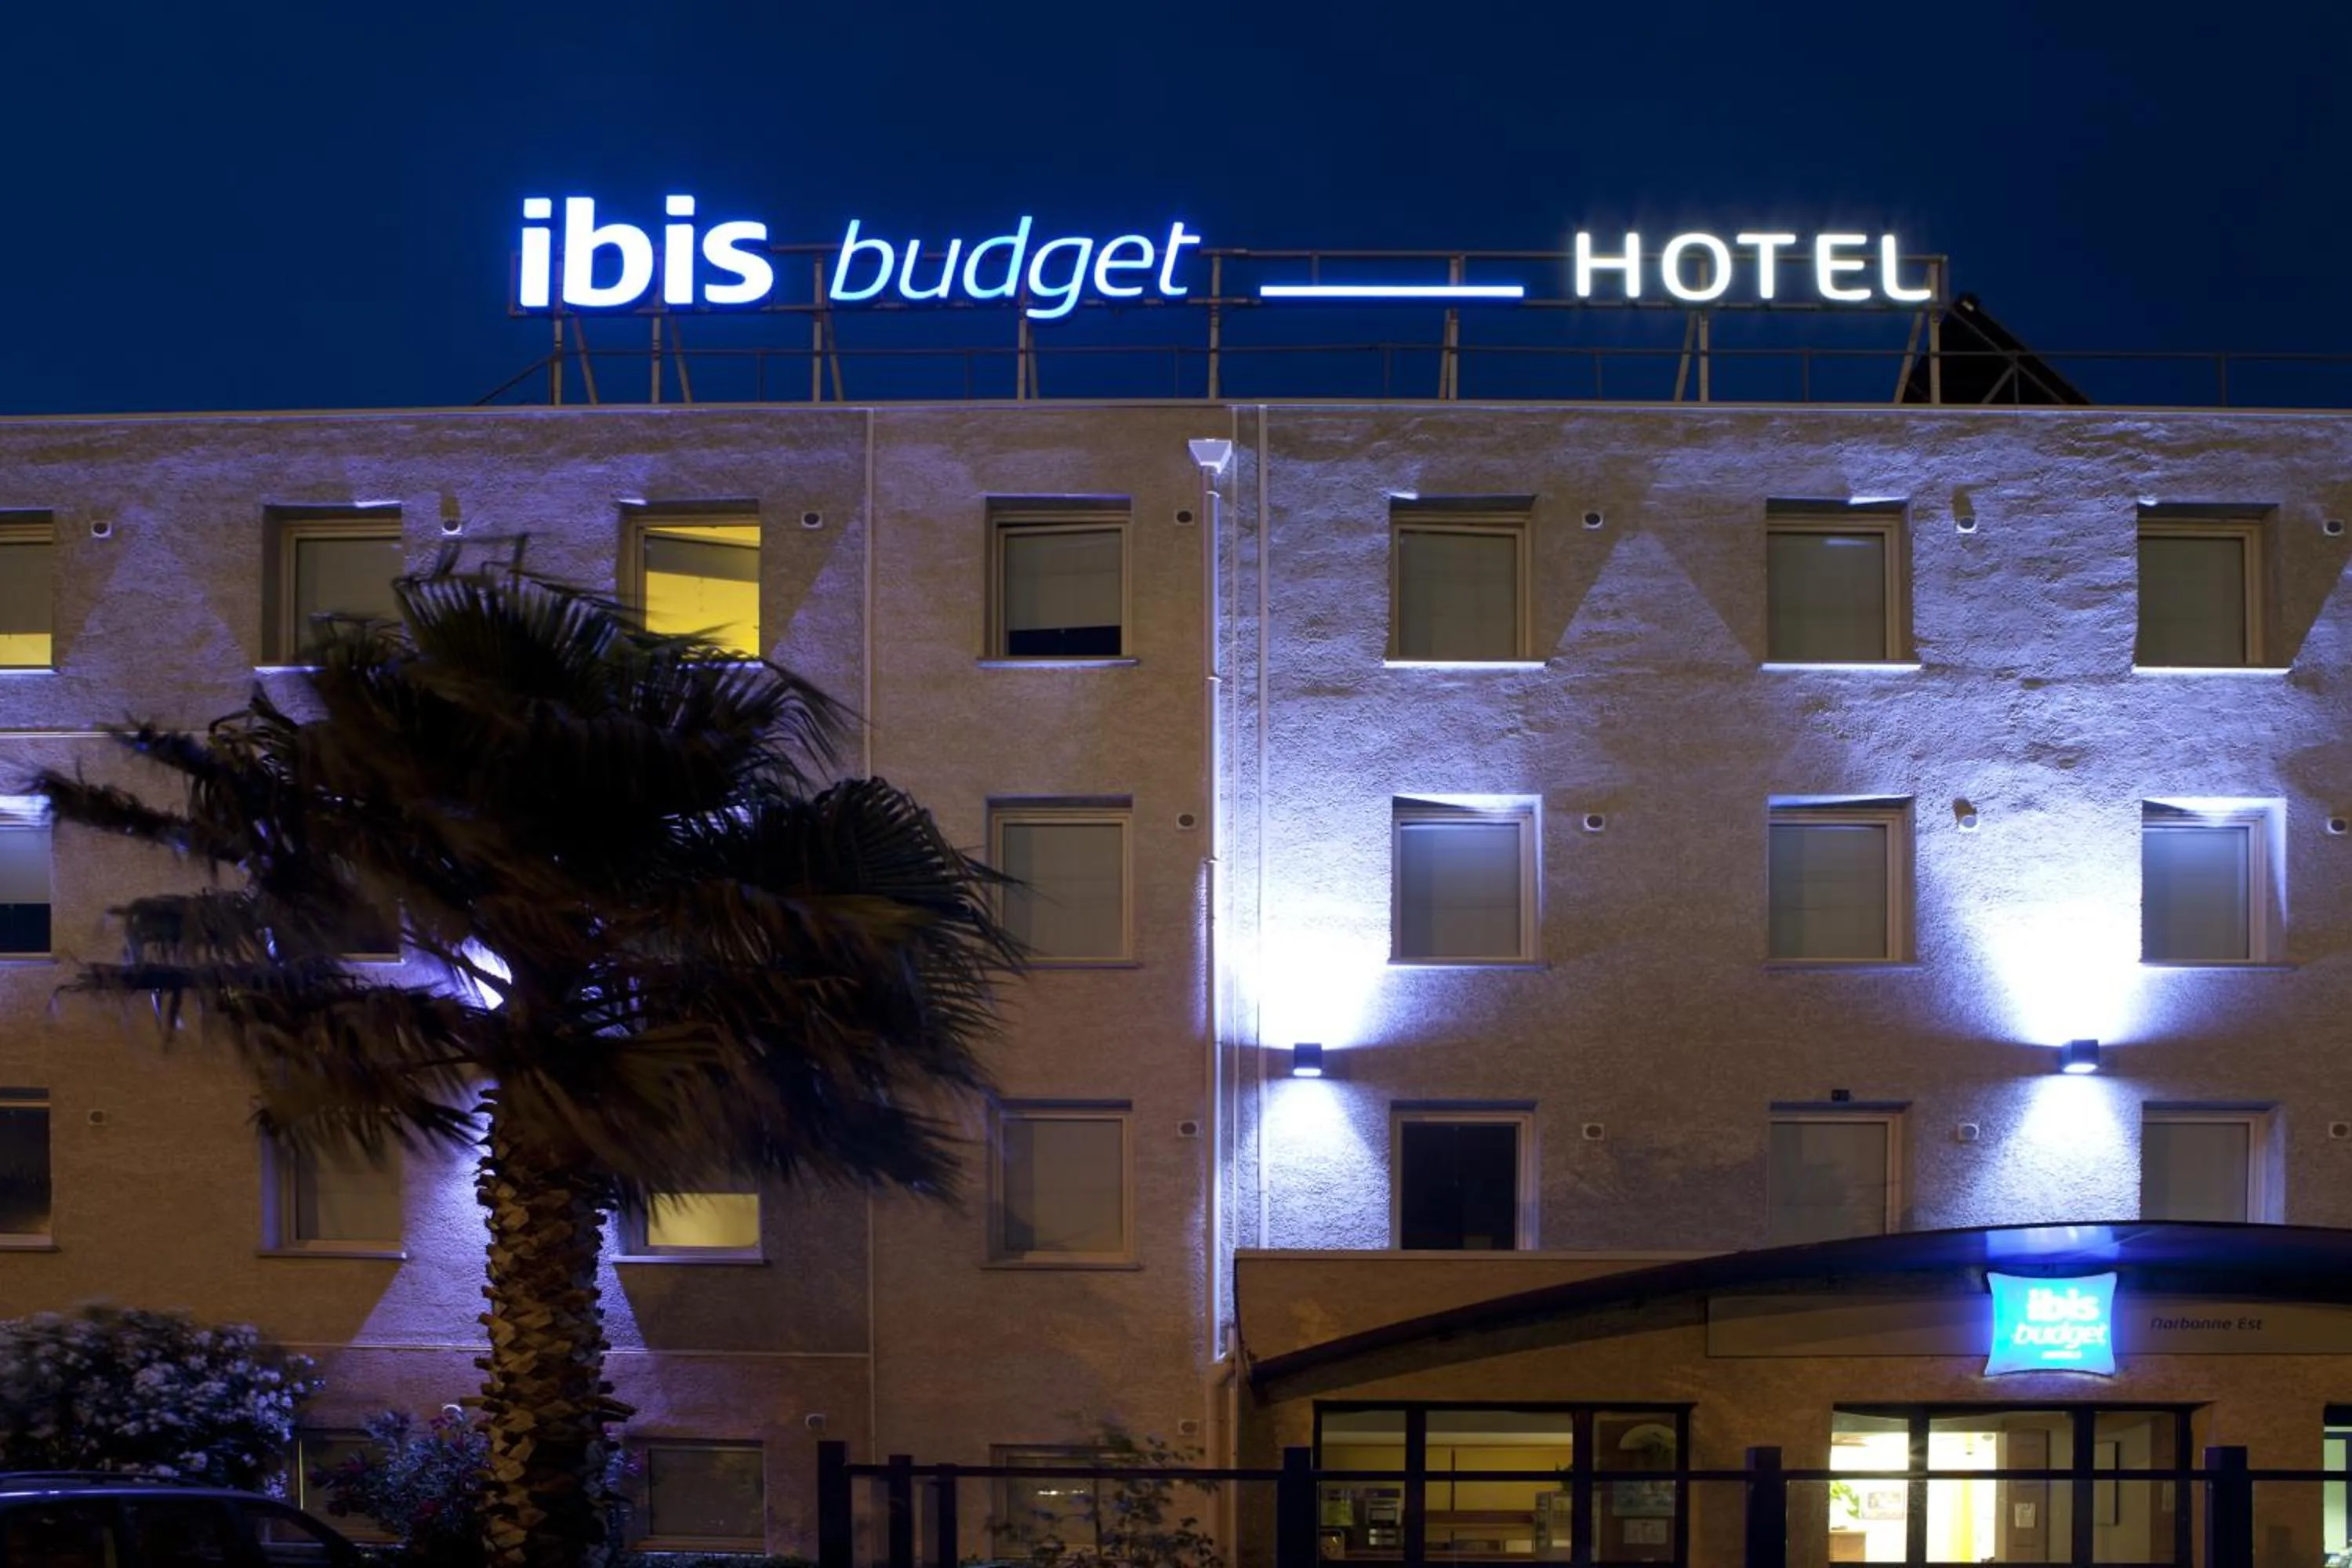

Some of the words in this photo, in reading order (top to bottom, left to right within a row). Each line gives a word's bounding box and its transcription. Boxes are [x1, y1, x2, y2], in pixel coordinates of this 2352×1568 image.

[519, 194, 775, 307] ibis
[829, 216, 1202, 319] budget
[1573, 230, 1933, 303] HOTEL
[2026, 1287, 2100, 1321] ibis
[2012, 1319, 2108, 1349] budget
[2237, 1316, 2263, 1330] Est
